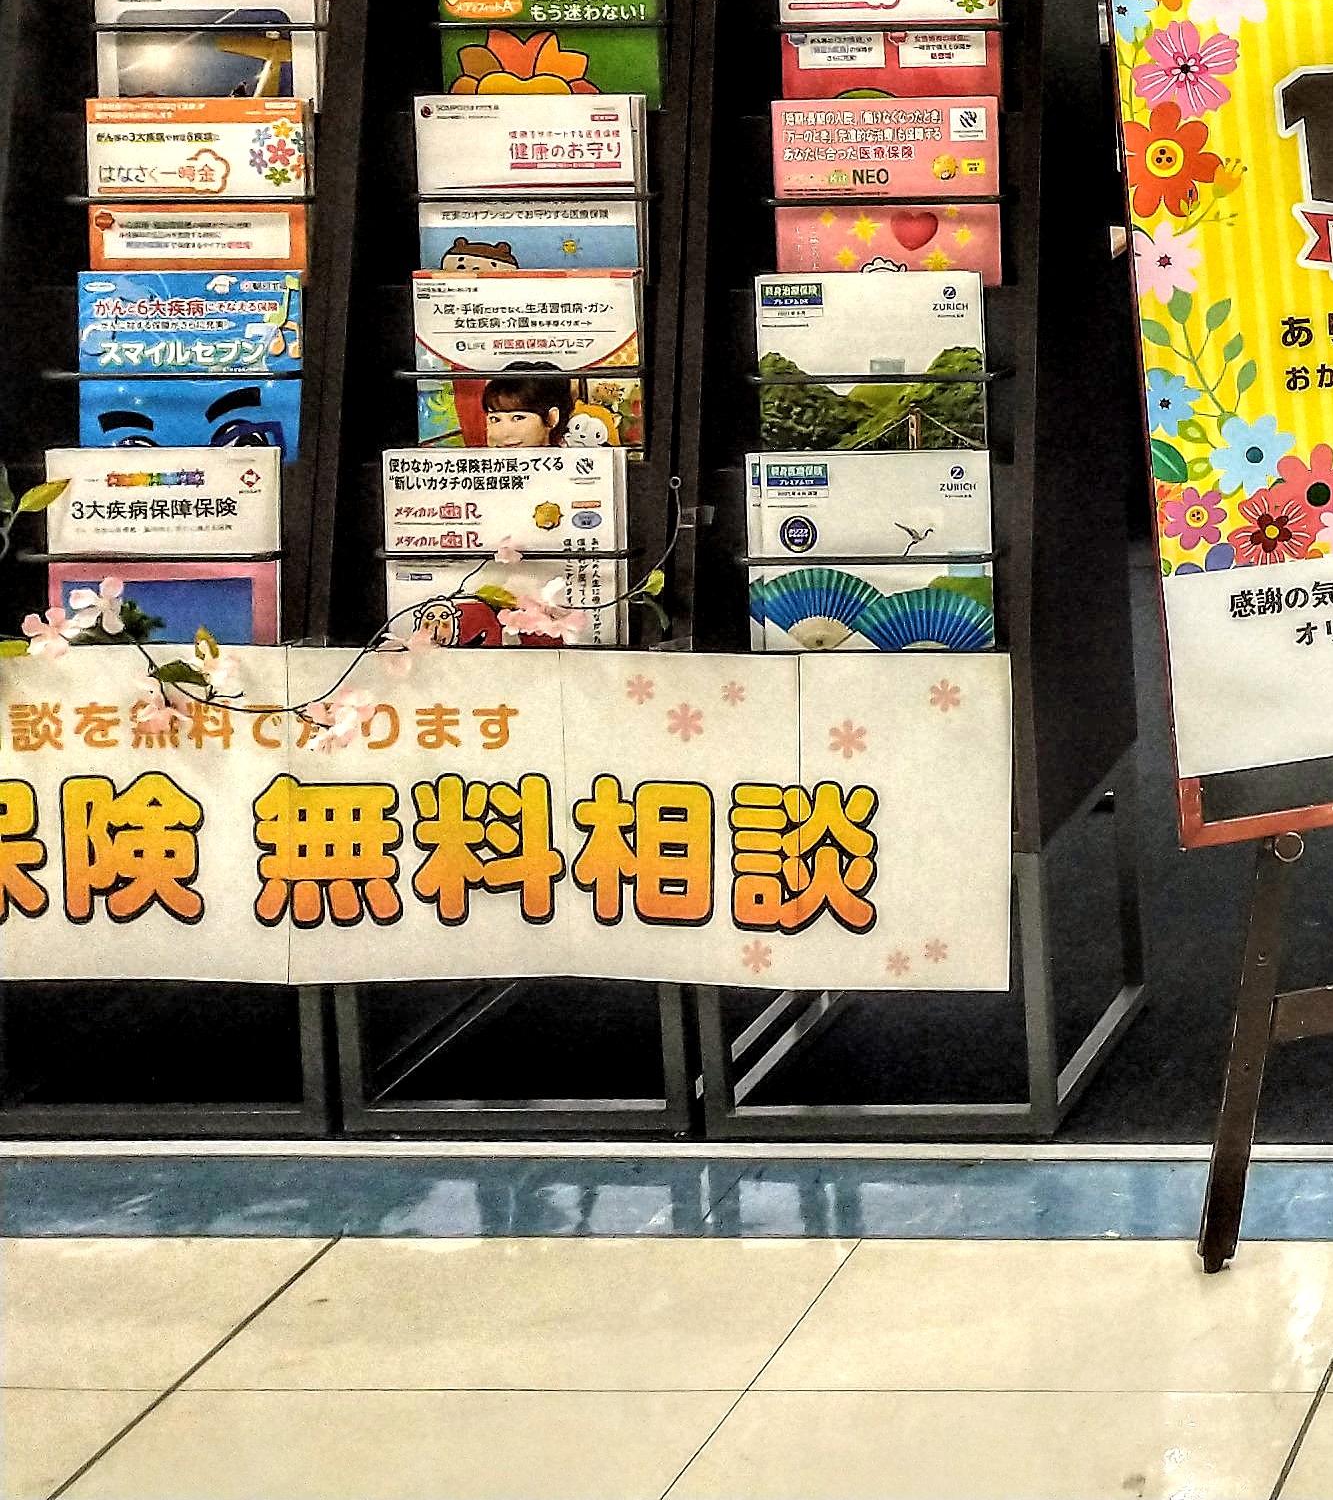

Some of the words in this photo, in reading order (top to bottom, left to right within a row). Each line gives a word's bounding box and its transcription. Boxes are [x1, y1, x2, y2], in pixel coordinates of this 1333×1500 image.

[530, 3, 646, 22] もう迷わない!
[508, 141, 622, 161] 健康のお守り
[783, 145, 915, 162] あなたに合った医療保険
[852, 168, 890, 185] NEO
[932, 302, 969, 312] ZURICH
[100, 340, 266, 367] スマイルセブン
[388, 456, 565, 474] 使わなかった保険料が戻ってくる
[939, 482, 977, 493] ZURICH
[71, 496, 238, 521] 3大疾病保障保険
[252, 770, 881, 936] 無料相談
